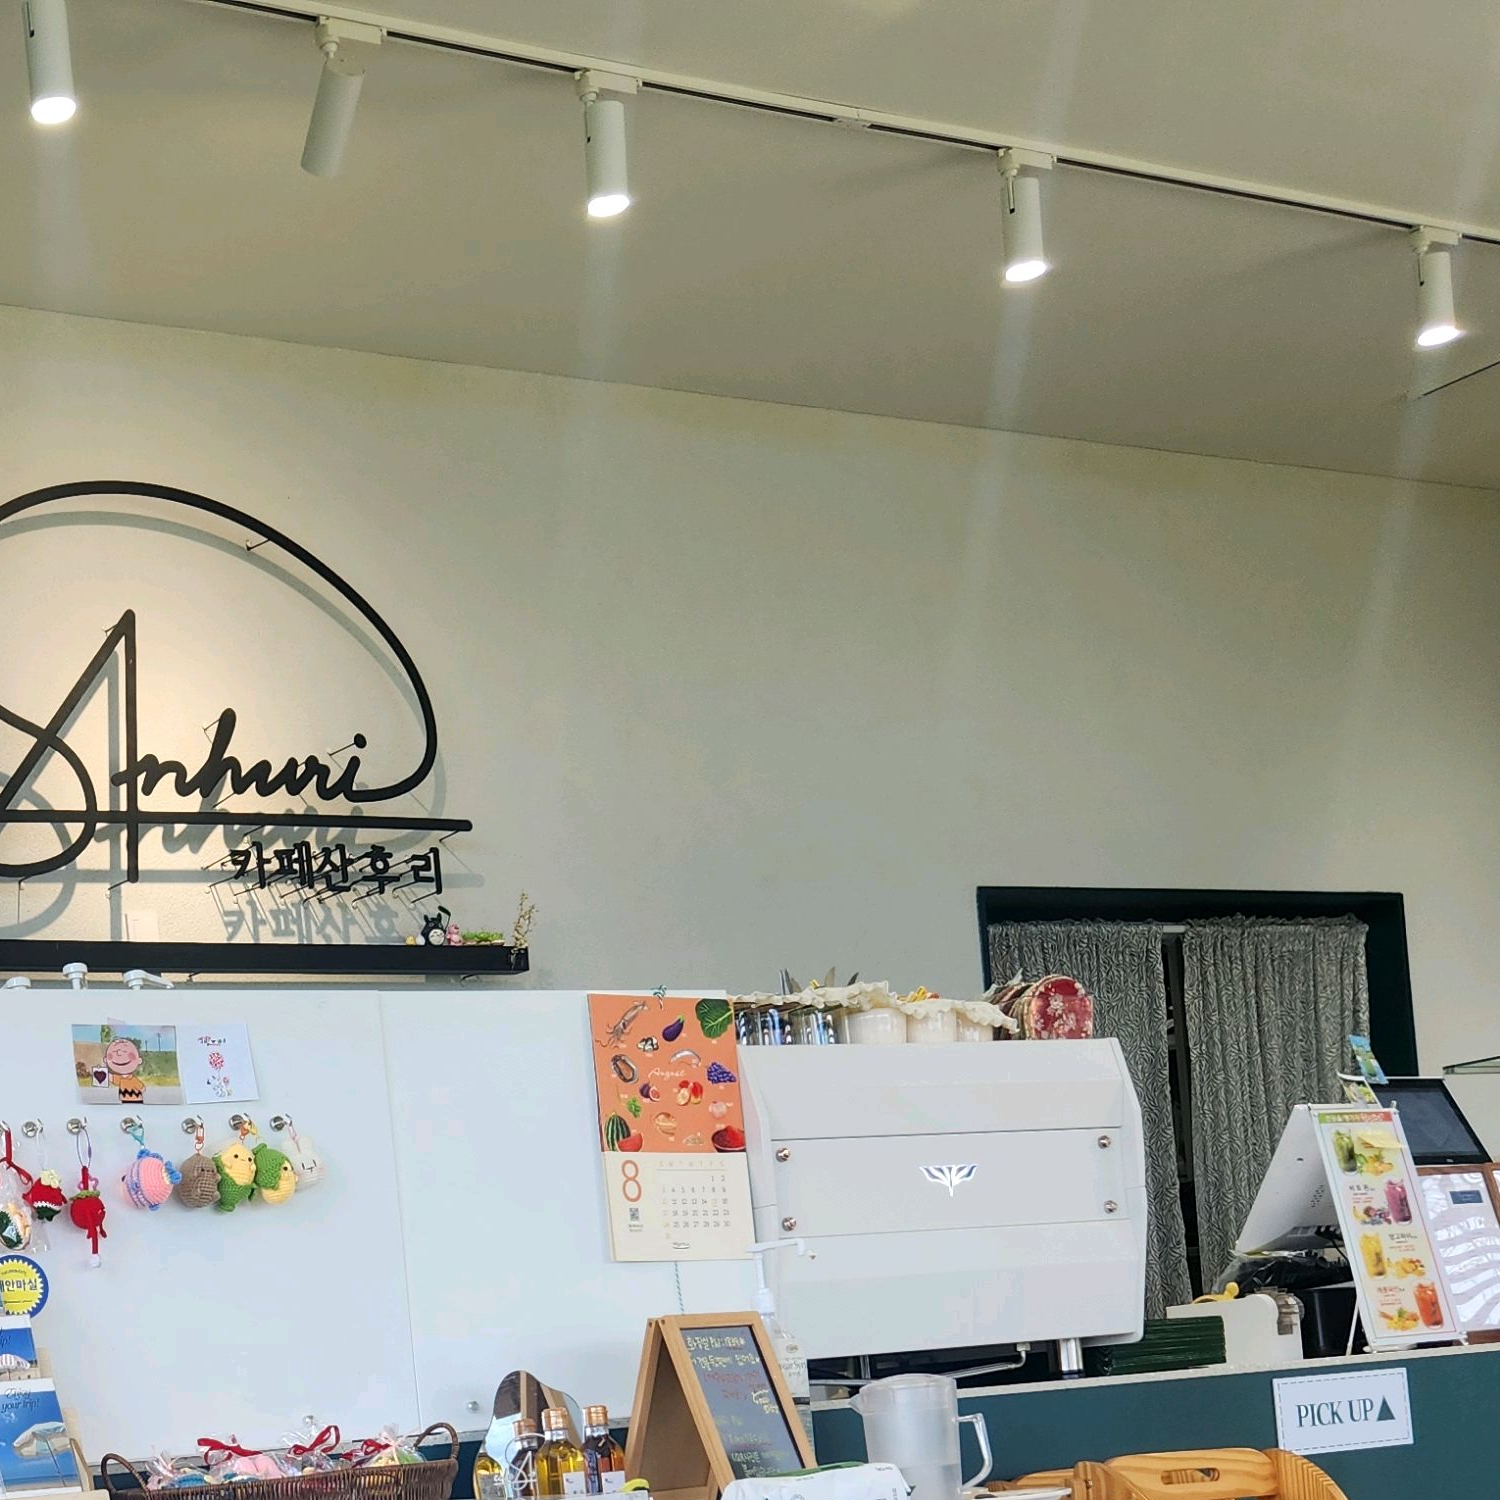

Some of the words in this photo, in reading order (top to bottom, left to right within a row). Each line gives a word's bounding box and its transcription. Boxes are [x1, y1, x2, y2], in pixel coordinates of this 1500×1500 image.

[230, 841, 442, 894] 카페산후리
[648, 1067, 685, 1080] August
[621, 1160, 642, 1202] 8
[1, 1400, 22, 1413] your
[22, 1398, 40, 1412] trip!
[1296, 1401, 1344, 1428] PICK
[1348, 1398, 1374, 1422] UP
